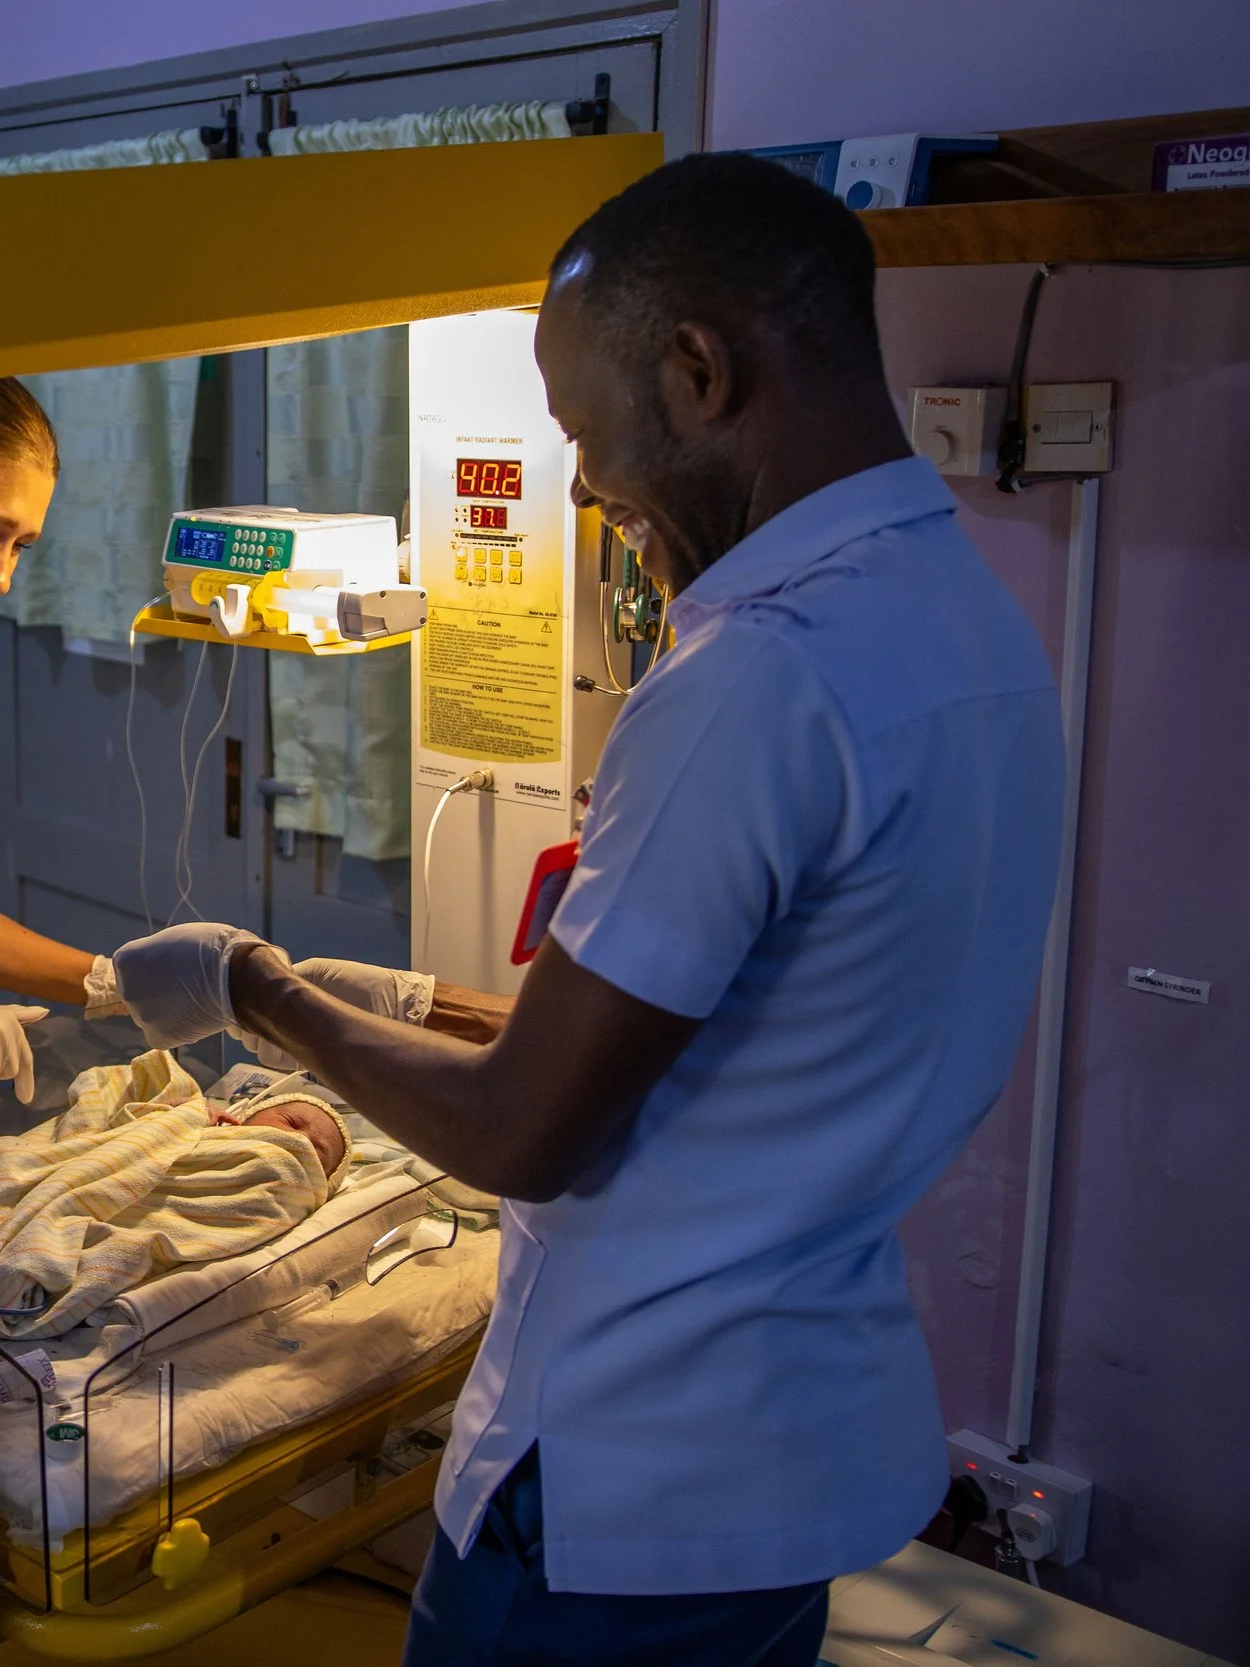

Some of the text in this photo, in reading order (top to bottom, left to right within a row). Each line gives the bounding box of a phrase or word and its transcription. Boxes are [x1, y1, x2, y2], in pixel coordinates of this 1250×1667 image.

[1187, 143, 1250, 167] Neog
[1187, 169, 1250, 180] Latex Powdered
[924, 396, 961, 406] TRONIC
[455, 435, 524, 445] INFANT RADIANT WARMER
[459, 462, 521, 496] 40.2
[477, 619, 501, 628] CAUTION
[536, 785, 561, 796] Exports
